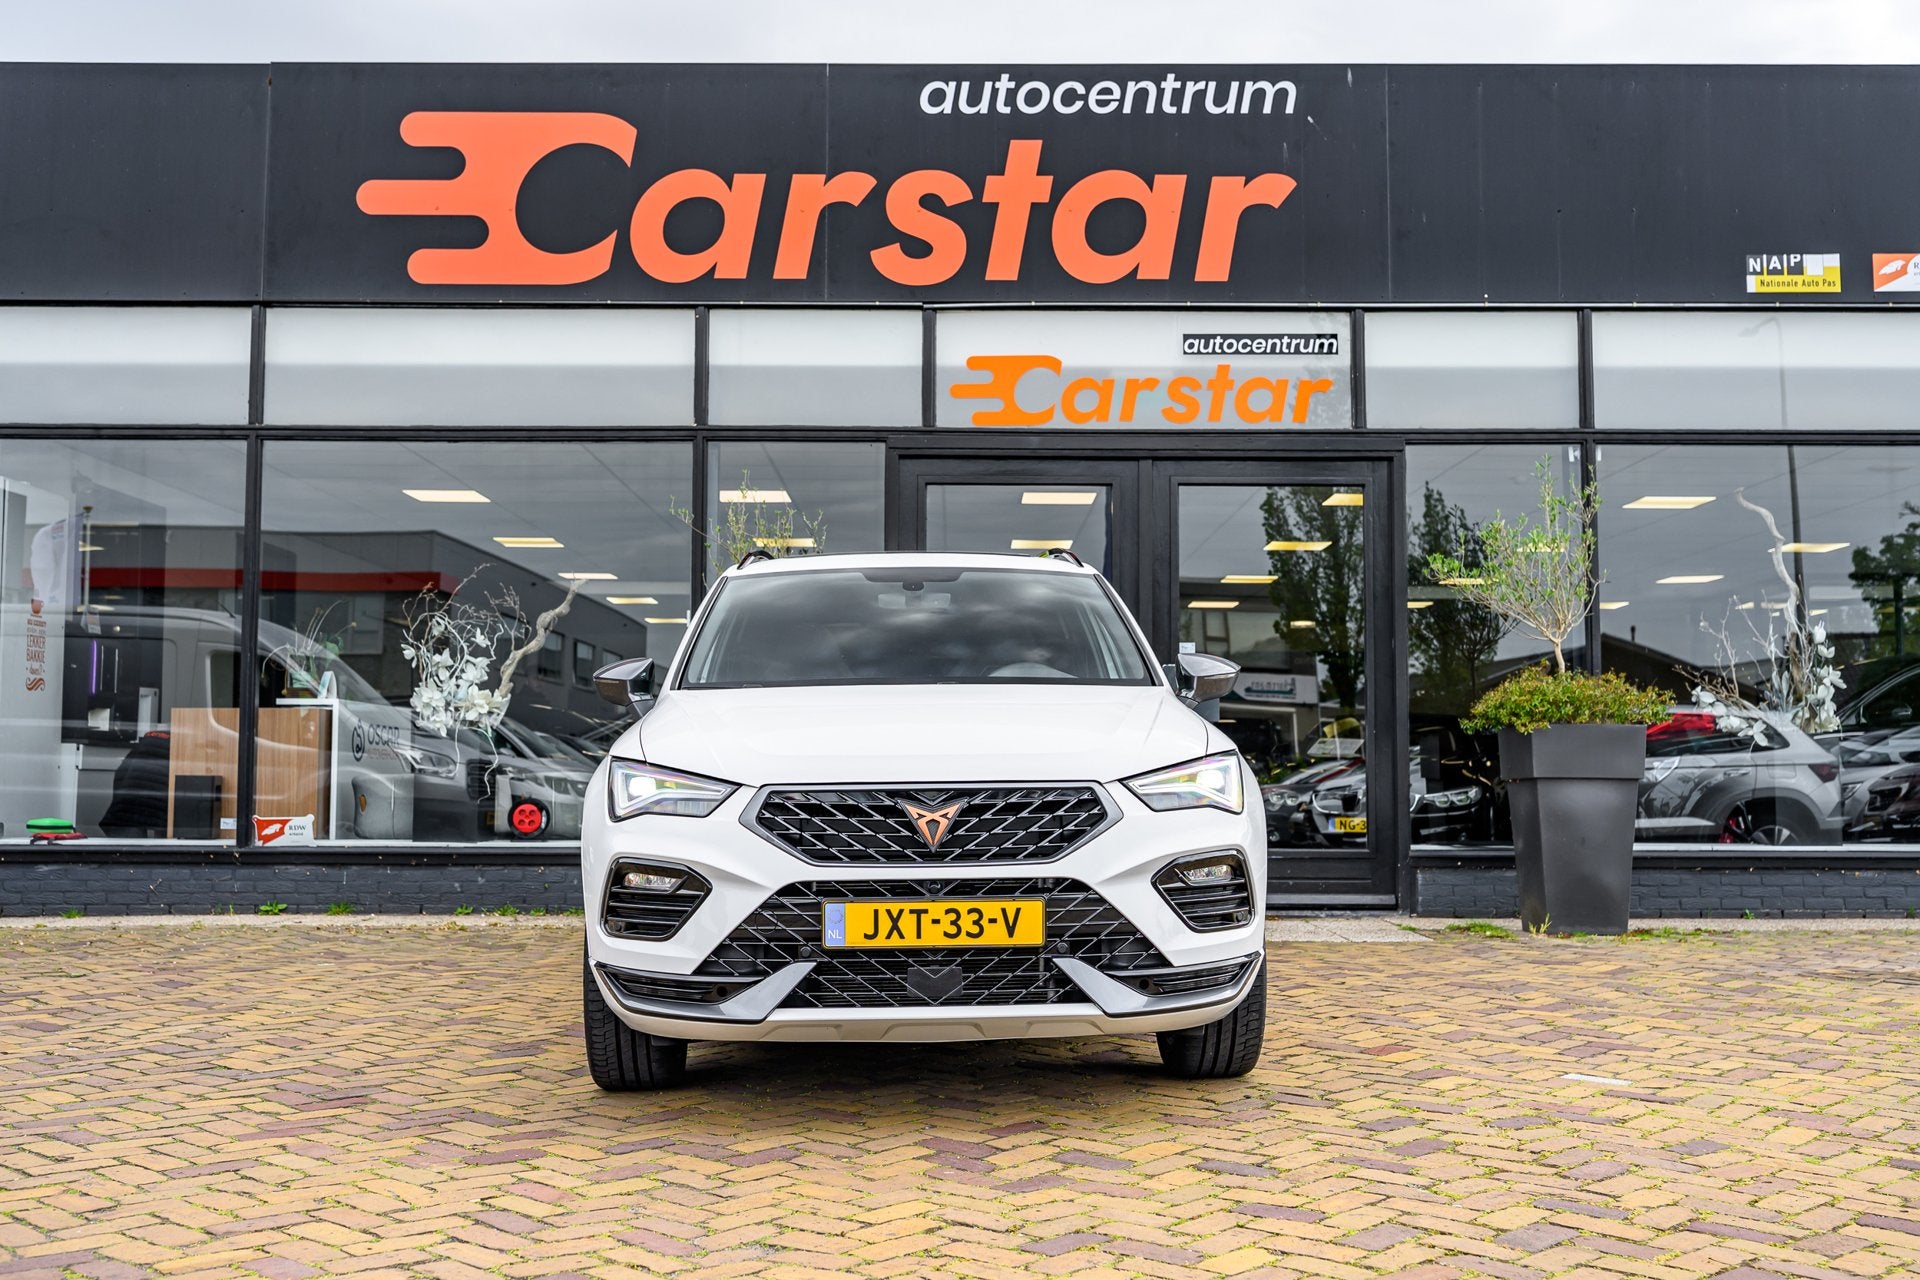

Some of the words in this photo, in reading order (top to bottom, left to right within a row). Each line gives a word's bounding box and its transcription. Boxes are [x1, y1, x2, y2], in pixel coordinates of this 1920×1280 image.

[919, 73, 1298, 115] autocentrum
[356, 110, 1298, 286] Carstar
[1760, 279, 1799, 288] Nationale
[1801, 278, 1820, 288] Auto
[1822, 278, 1837, 288] Pas
[1183, 335, 1339, 355] autocentrum
[949, 354, 1334, 427] Carstar
[828, 930, 843, 939] NL
[863, 907, 1022, 940] JXT-33-V
